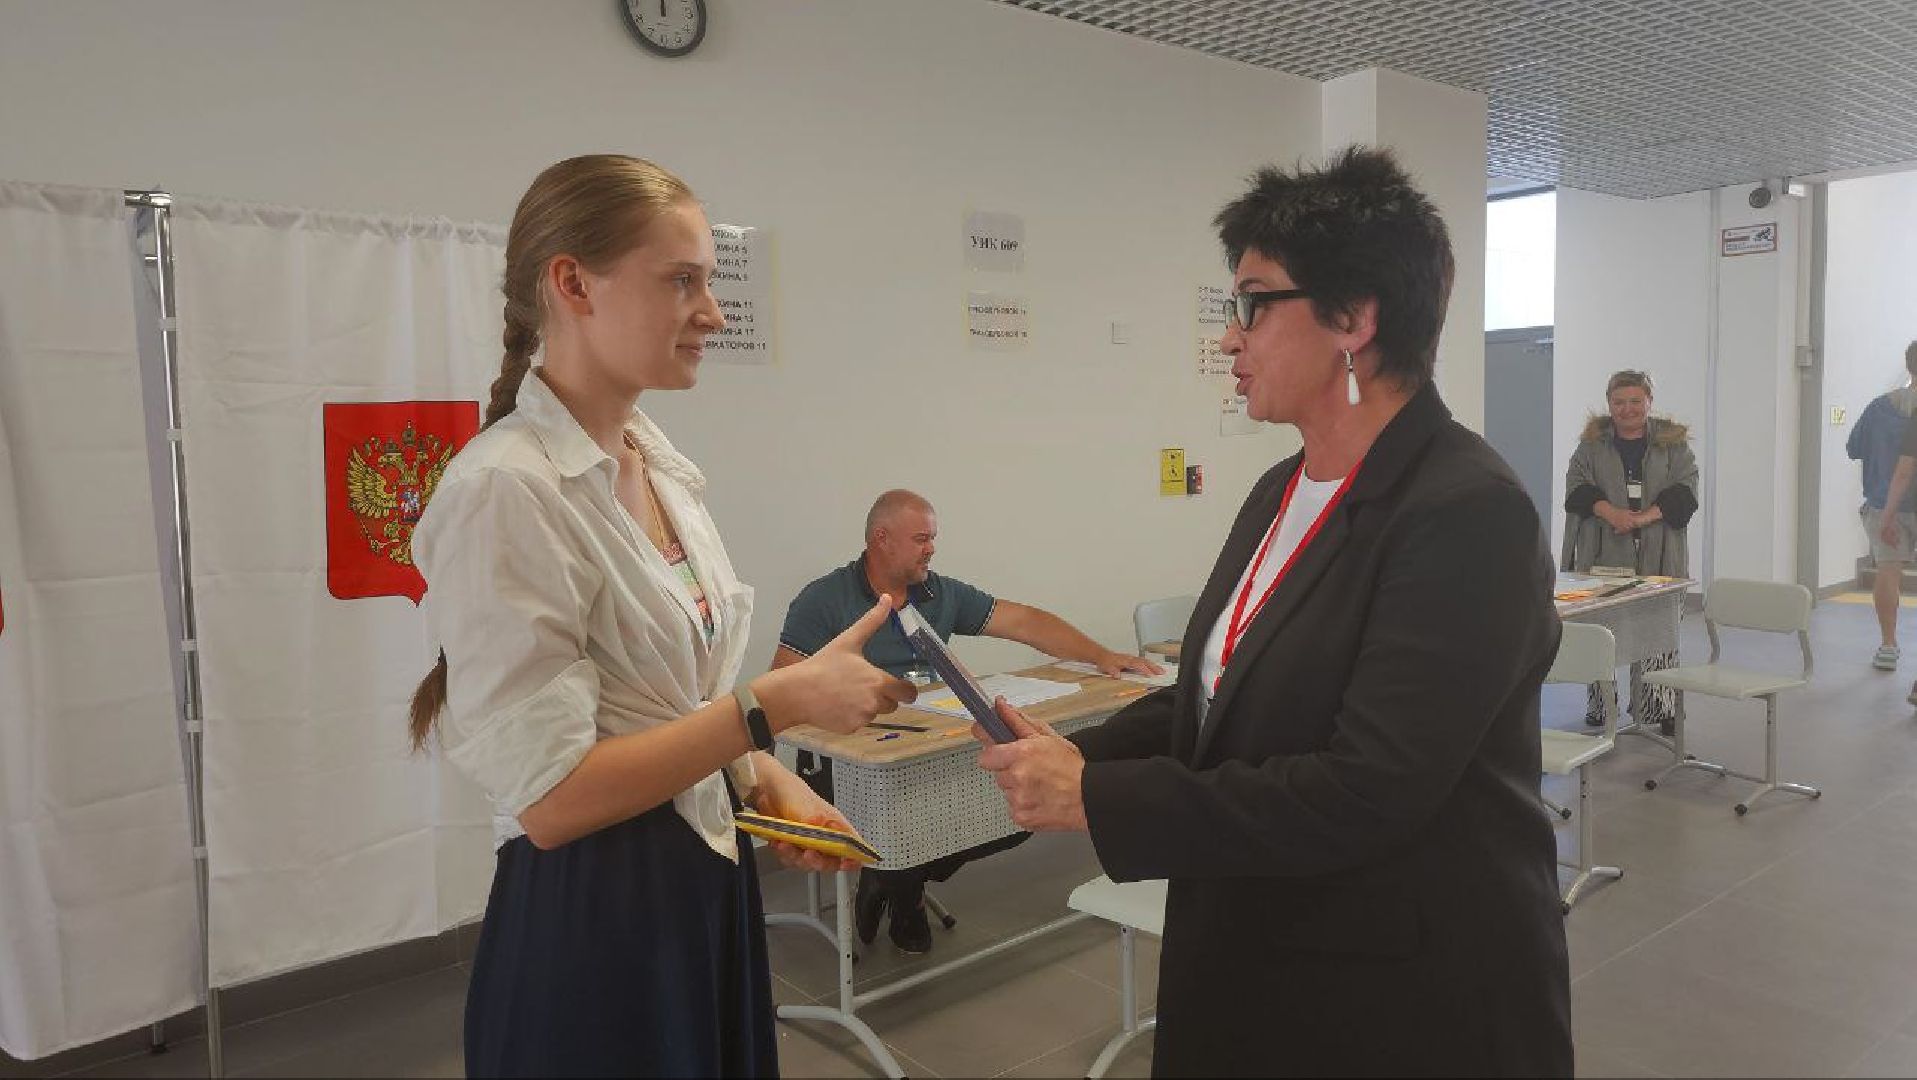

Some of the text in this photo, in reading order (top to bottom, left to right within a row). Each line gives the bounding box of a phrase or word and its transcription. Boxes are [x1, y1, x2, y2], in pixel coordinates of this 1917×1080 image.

[970, 235, 998, 250] УИК
[715, 244, 740, 255] КИНА
[716, 258, 740, 268] КИНА
[717, 300, 742, 309] КИНА
[704, 340, 755, 351] ВИАТОРОВ
